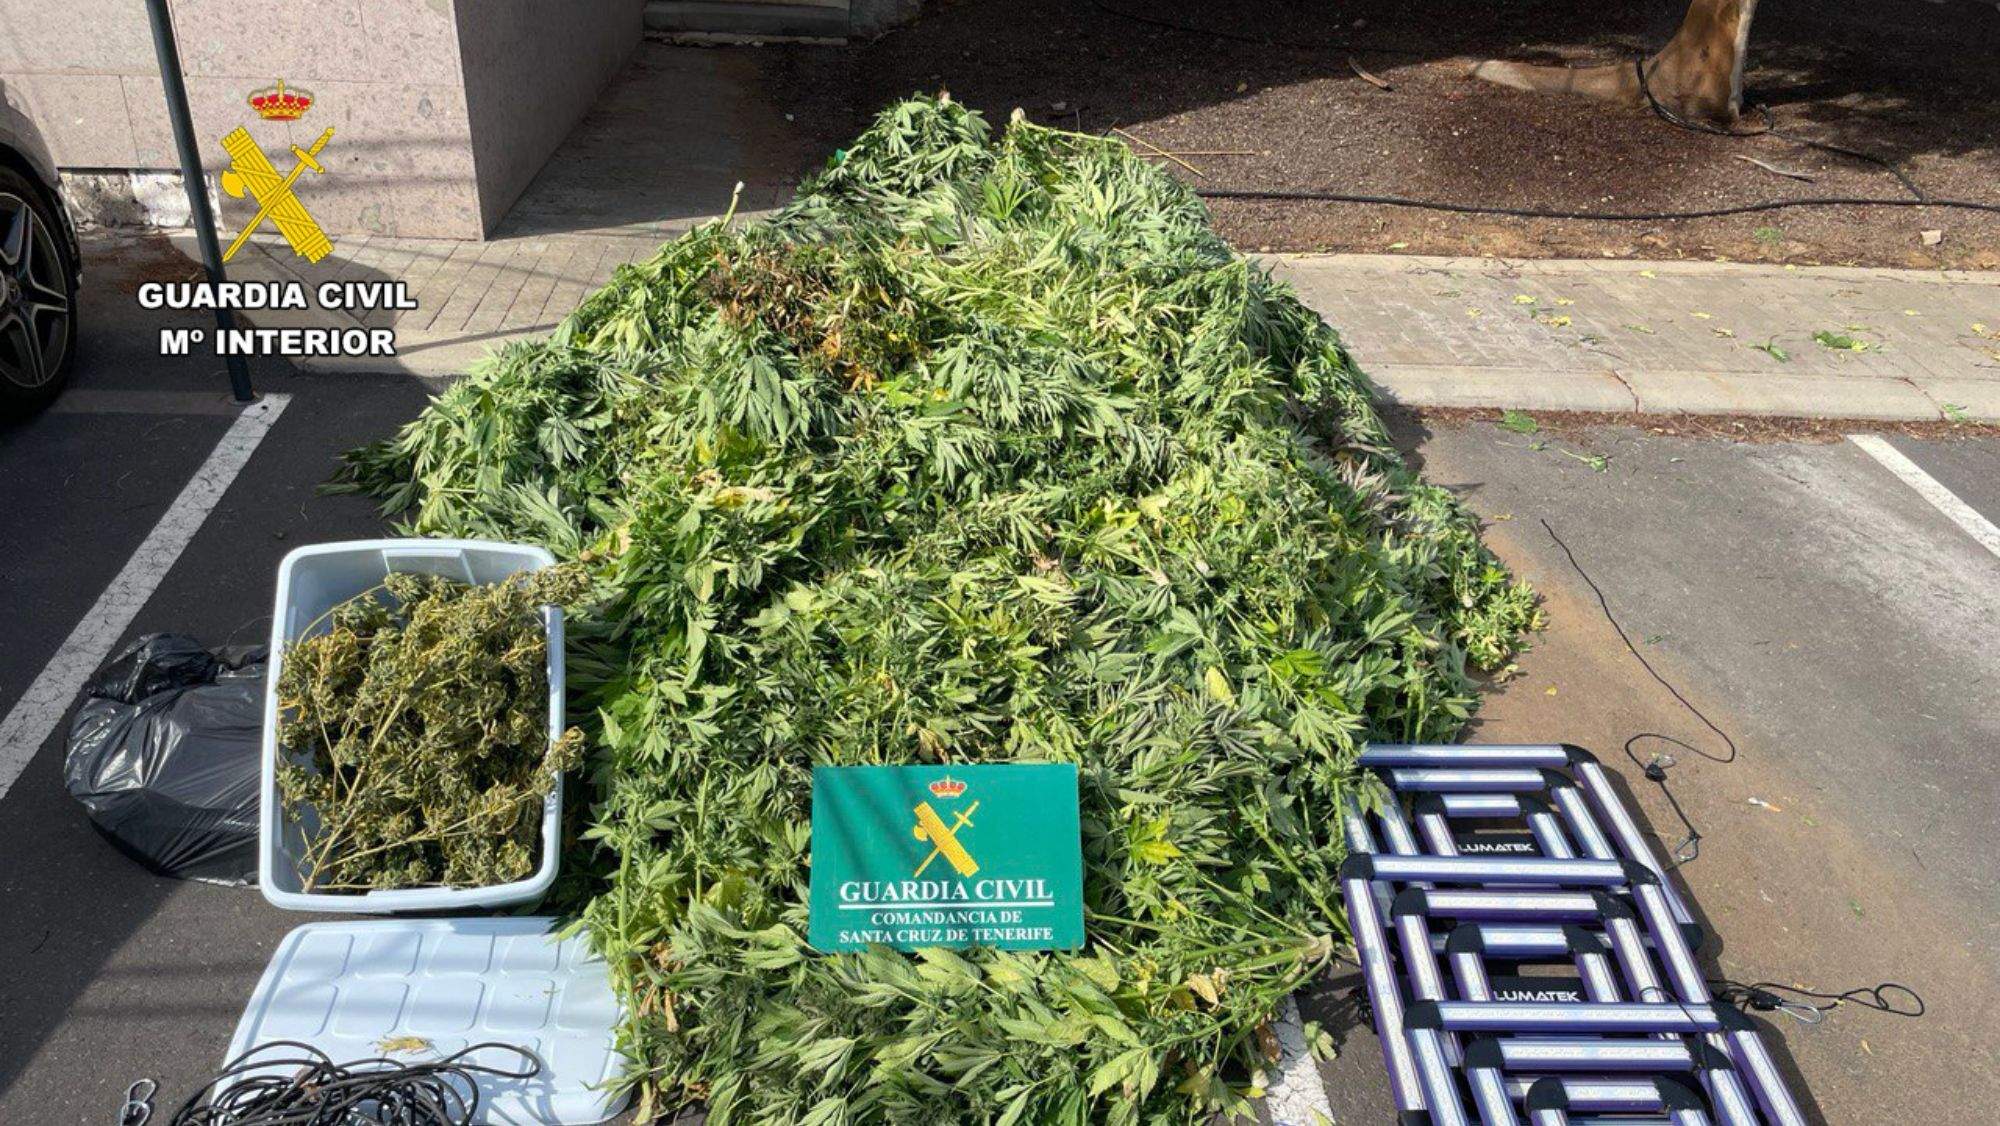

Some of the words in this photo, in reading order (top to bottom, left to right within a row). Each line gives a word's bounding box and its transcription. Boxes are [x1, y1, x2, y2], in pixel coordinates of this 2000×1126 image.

[1457, 843, 1534, 852] LUMATEK
[840, 881, 968, 902] GUARDIA
[975, 879, 1054, 900] CIVIL
[871, 912, 998, 925] COMANDANCIA
[1002, 911, 1022, 924] DE
[840, 931, 893, 944] SANTA
[897, 929, 942, 944] CRUZ
[946, 929, 969, 943] DE
[973, 927, 1054, 942] TENERIFE
[1494, 991, 1580, 1002] LUMATEK
